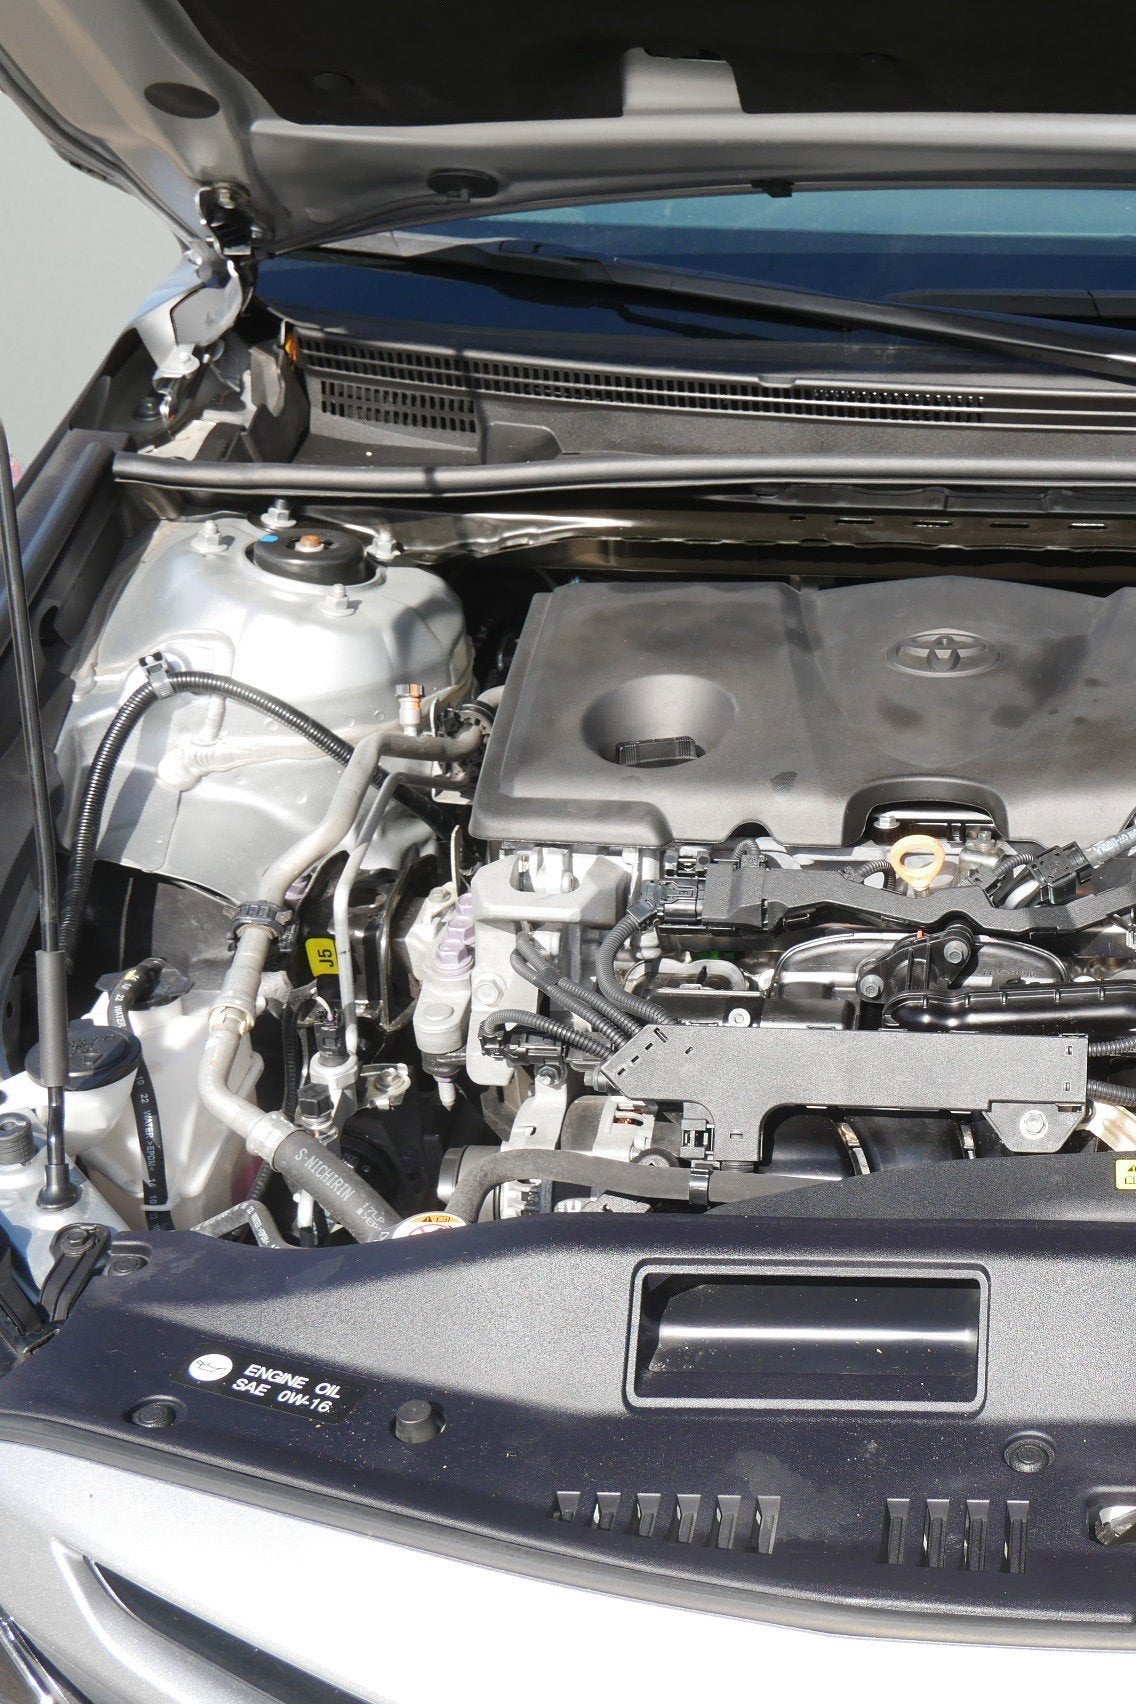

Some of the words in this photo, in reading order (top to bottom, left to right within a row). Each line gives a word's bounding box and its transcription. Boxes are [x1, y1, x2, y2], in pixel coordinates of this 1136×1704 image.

[317, 949, 334, 967] J5
[114, 1005, 127, 1028] WATER
[136, 1075, 145, 1086] 10
[139, 1093, 150, 1104] 22
[143, 1109, 155, 1139] WATER
[243, 1363, 310, 1389] ENGINE
[315, 1382, 341, 1399] OIL
[232, 1378, 271, 1397] SAE
[277, 1390, 333, 1413] 0W-16
